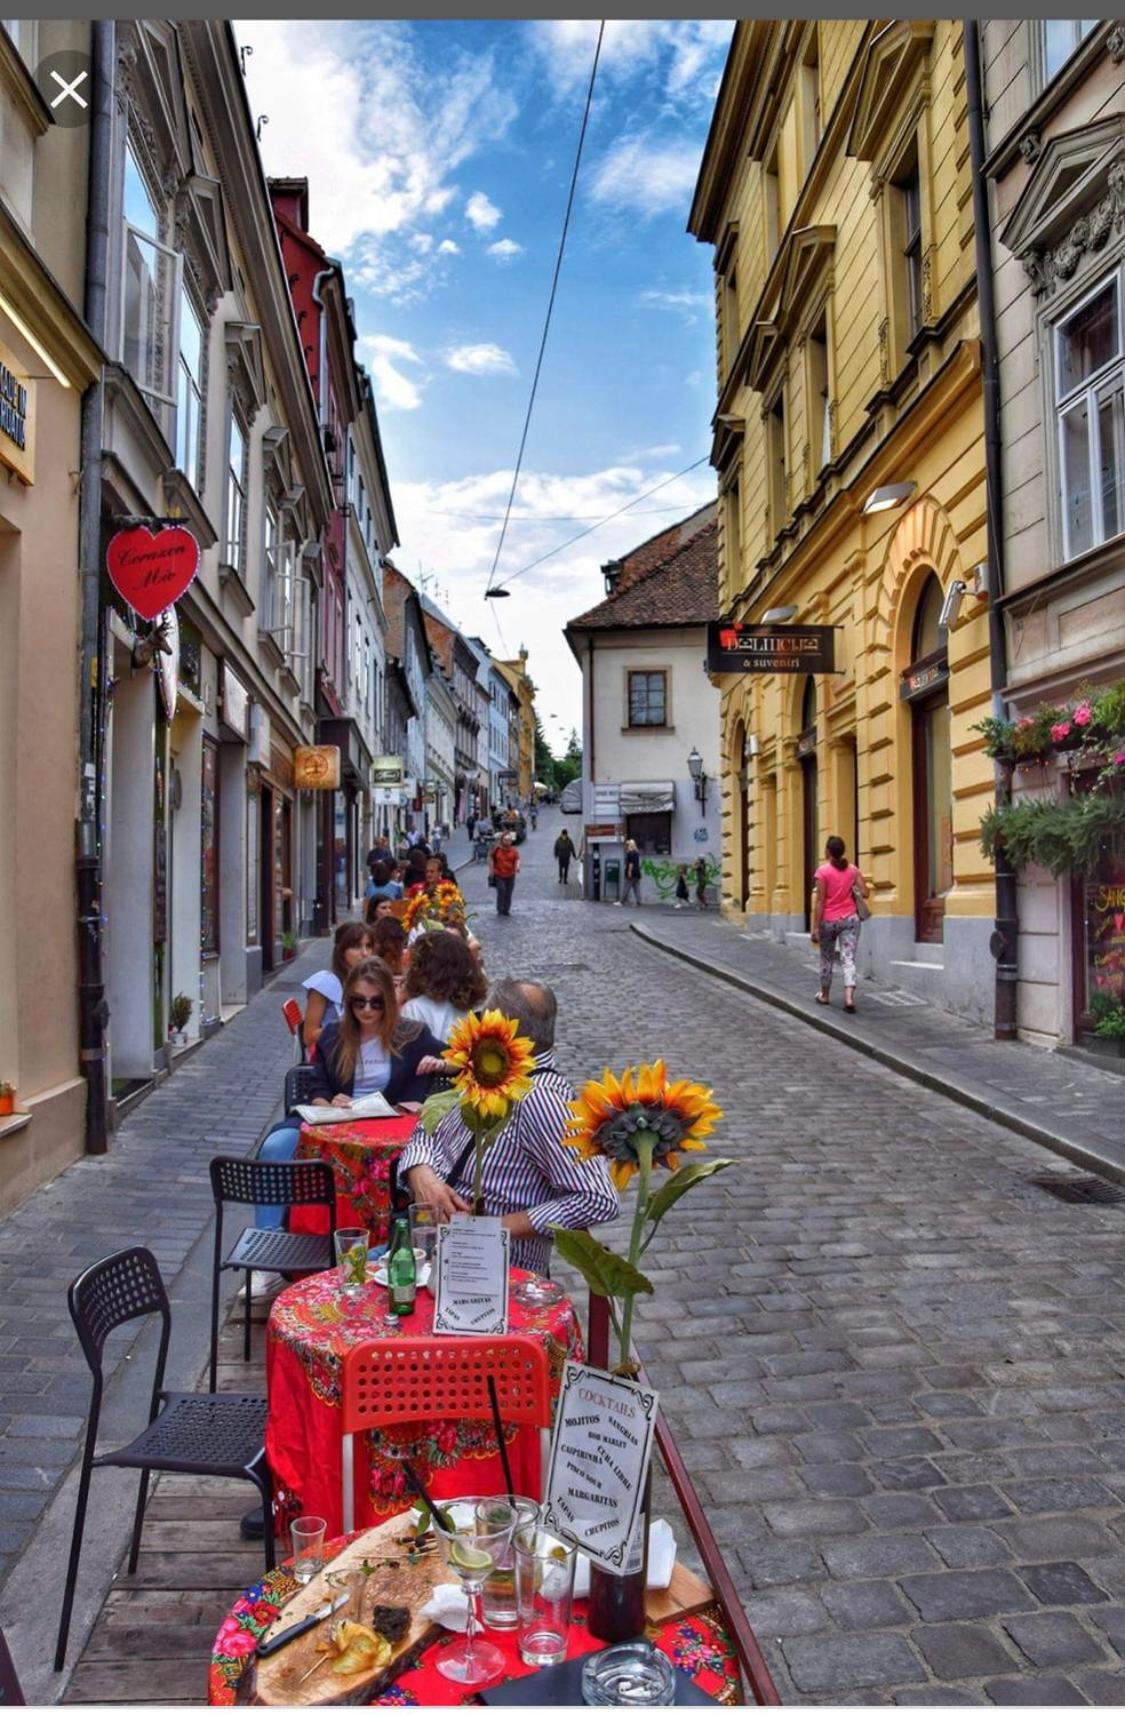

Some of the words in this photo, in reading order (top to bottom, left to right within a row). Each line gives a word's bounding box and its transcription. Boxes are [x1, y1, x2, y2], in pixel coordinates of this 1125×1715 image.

[743, 658, 751, 667] &
[753, 657, 800, 668] suveniri
[578, 1387, 636, 1418] COCKTAILS
[564, 1414, 601, 1428] MOJITOS
[568, 1487, 618, 1508] MARGARITAS
[557, 1496, 575, 1522] TAPAS
[584, 1517, 620, 1537] CHUPITOS
